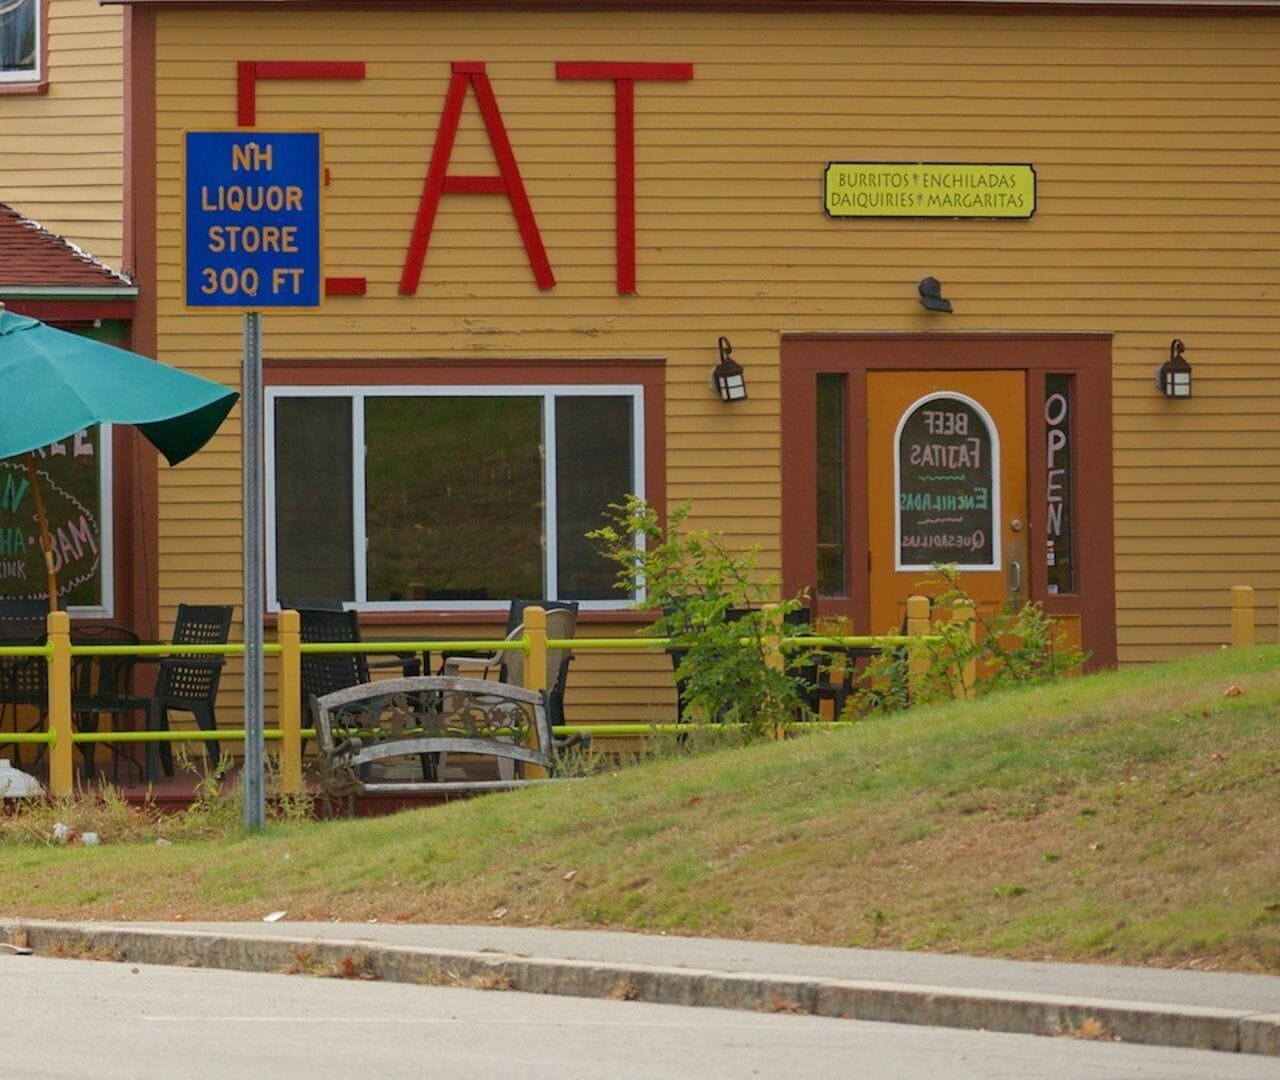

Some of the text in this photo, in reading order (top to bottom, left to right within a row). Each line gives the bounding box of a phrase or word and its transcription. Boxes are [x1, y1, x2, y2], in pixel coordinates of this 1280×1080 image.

[231, 144, 273, 171] NH
[839, 173, 1016, 189] BURRITOS ENCHILADAS
[202, 186, 303, 212] LIQUOR
[831, 192, 1024, 208] DAIQUIRIES MARGARITAS
[208, 227, 298, 253] STORE
[201, 267, 305, 296] 300 FT
[1045, 393, 1068, 536] OPEN
